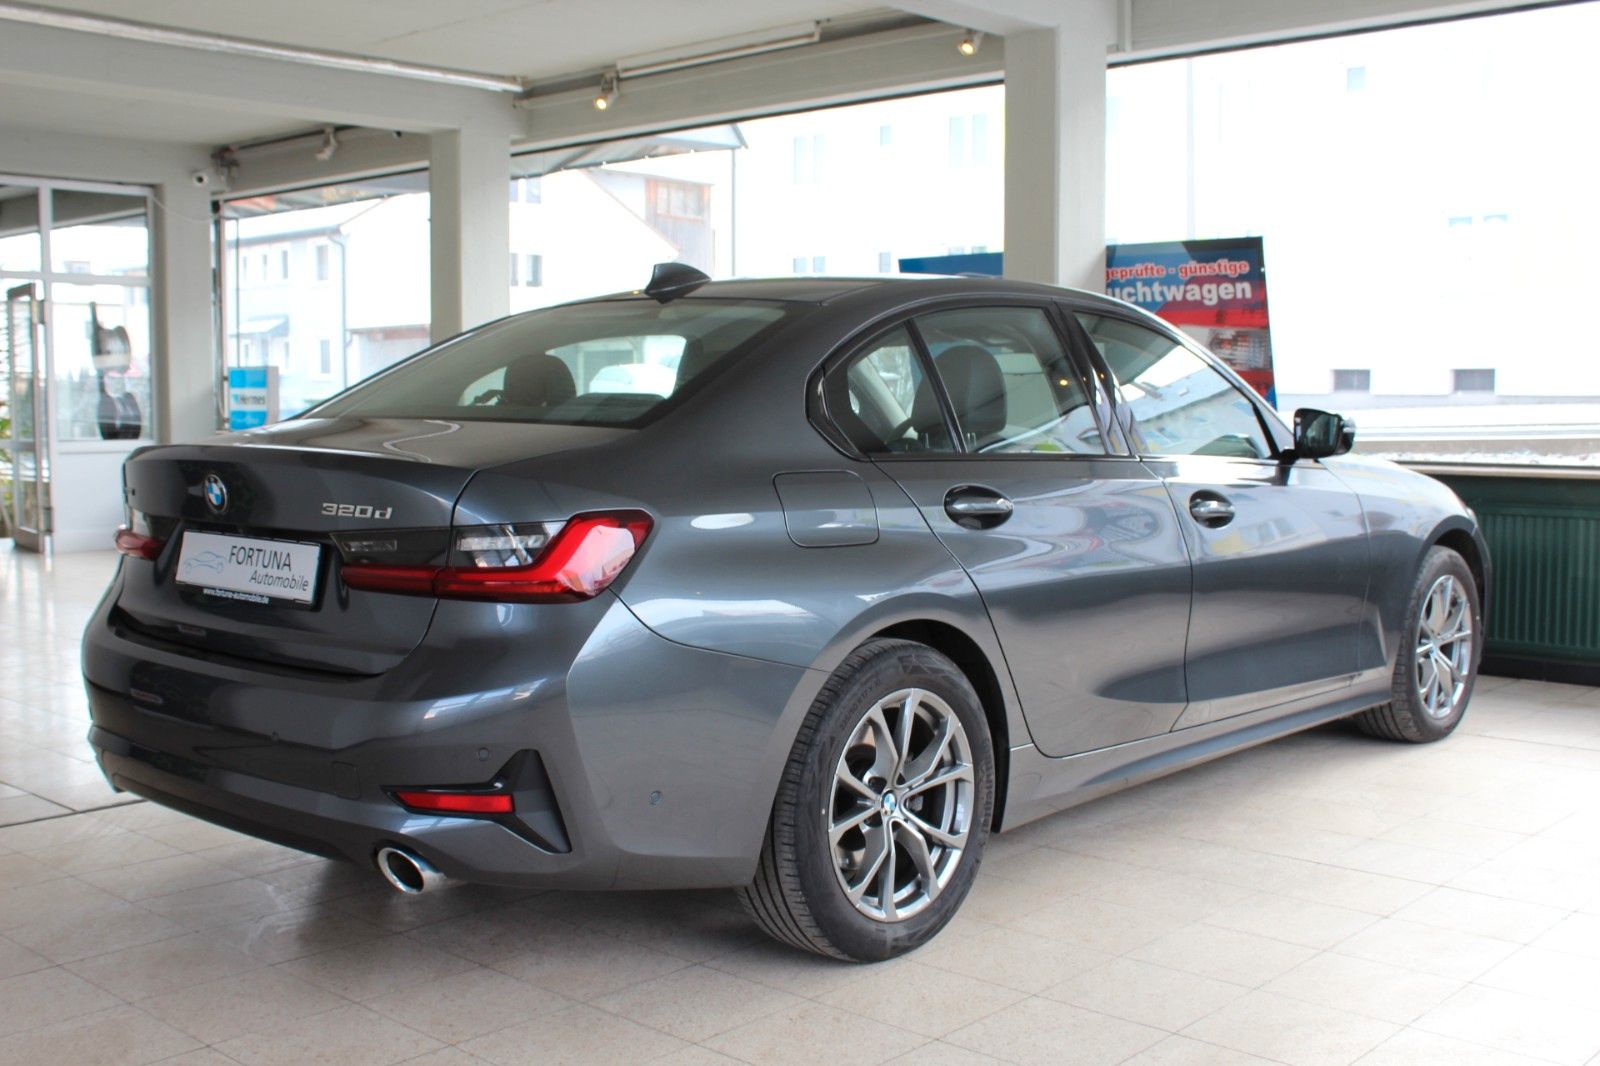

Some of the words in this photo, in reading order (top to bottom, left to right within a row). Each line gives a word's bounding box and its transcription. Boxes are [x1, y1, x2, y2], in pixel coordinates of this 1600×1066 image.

[1179, 258, 1250, 279] günstige
[321, 501, 393, 520] 320d
[228, 545, 293, 571] FORTUNA
[248, 569, 309, 592] Automobile
